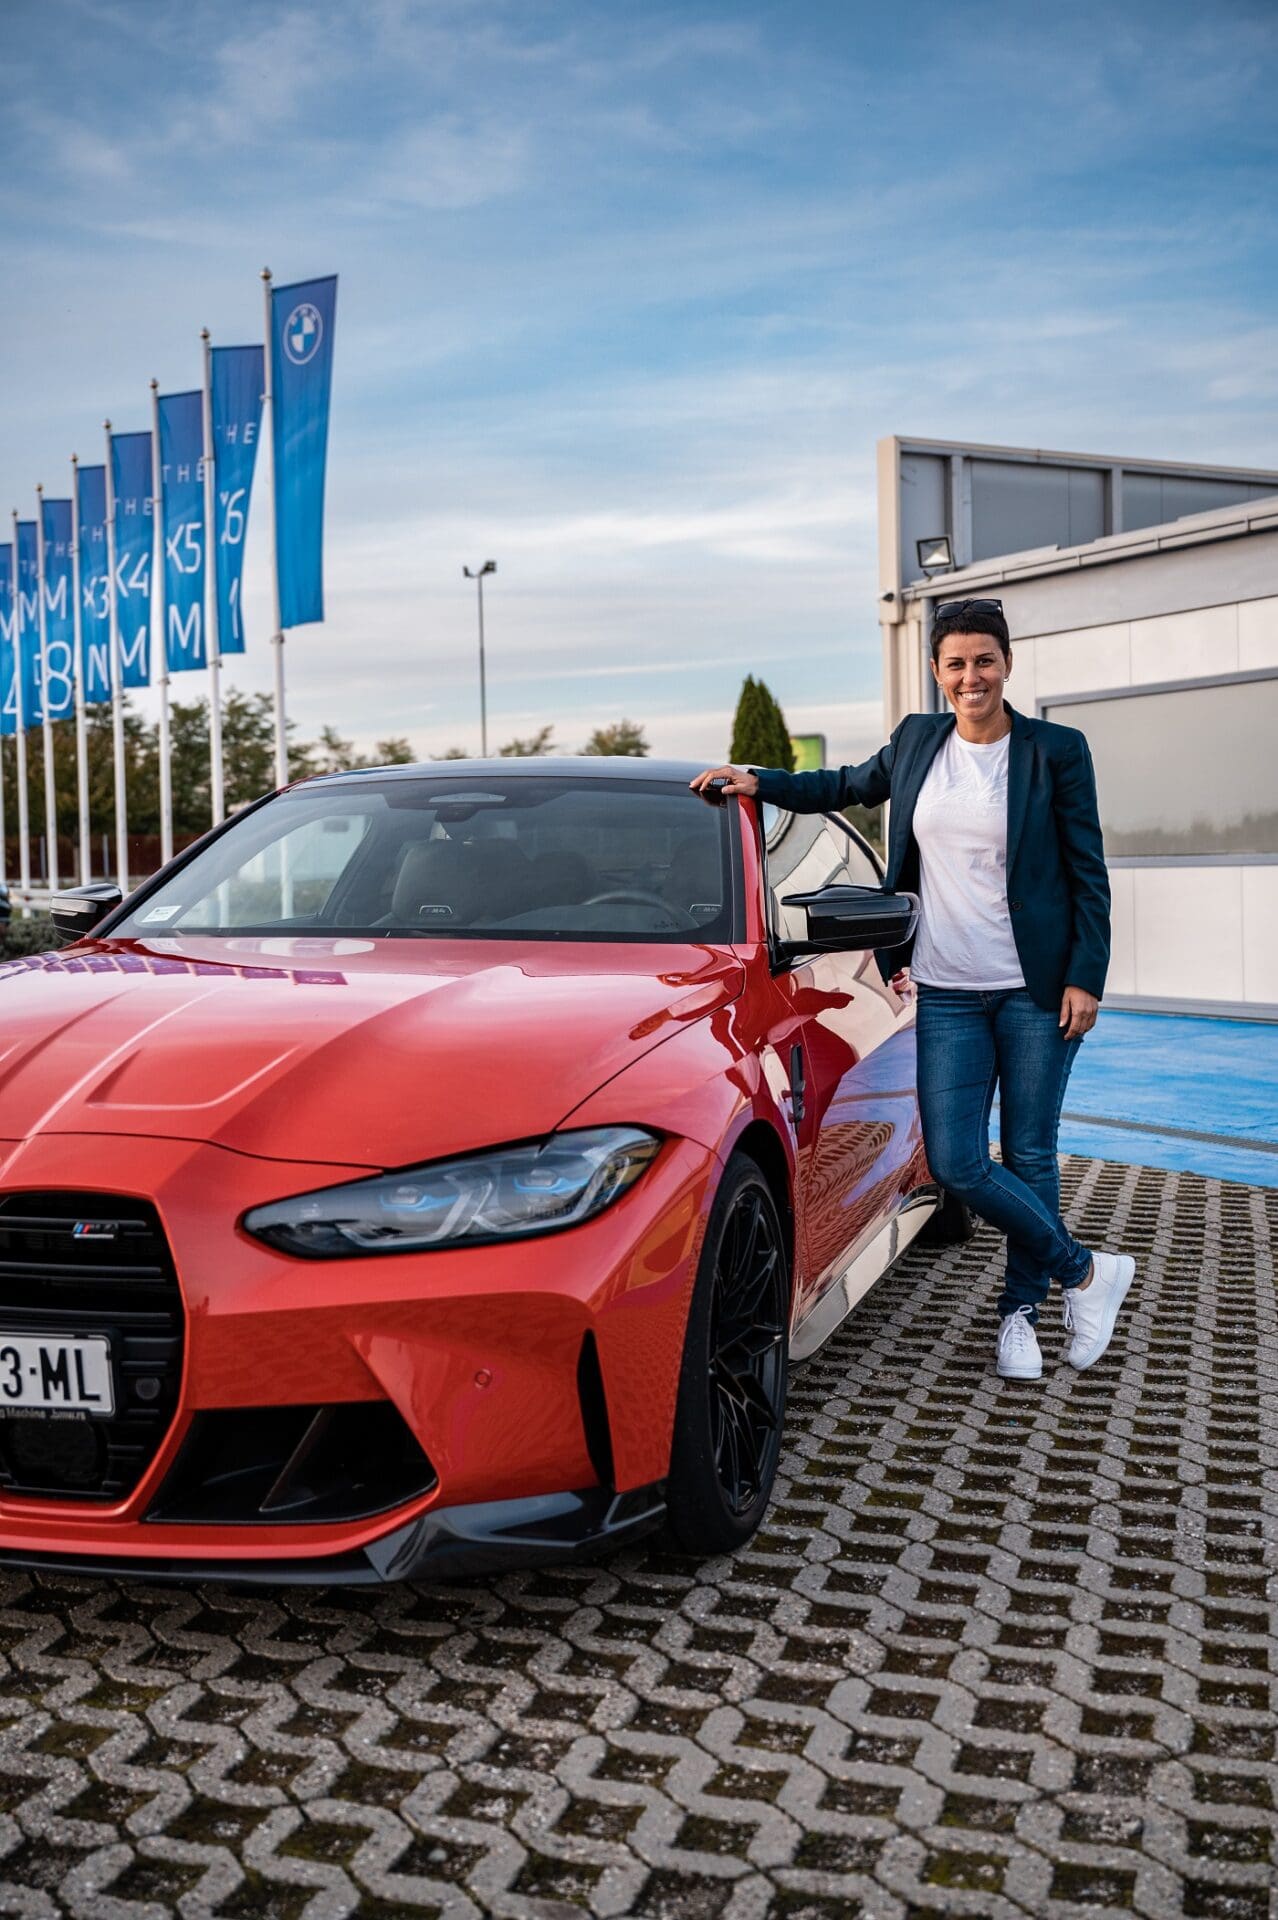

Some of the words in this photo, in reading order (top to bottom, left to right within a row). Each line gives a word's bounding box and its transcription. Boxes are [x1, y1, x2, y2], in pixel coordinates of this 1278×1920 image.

[217, 422, 256, 444] HE
[166, 522, 202, 574] X5
[169, 602, 200, 659] M
[46, 641, 72, 711] 8
